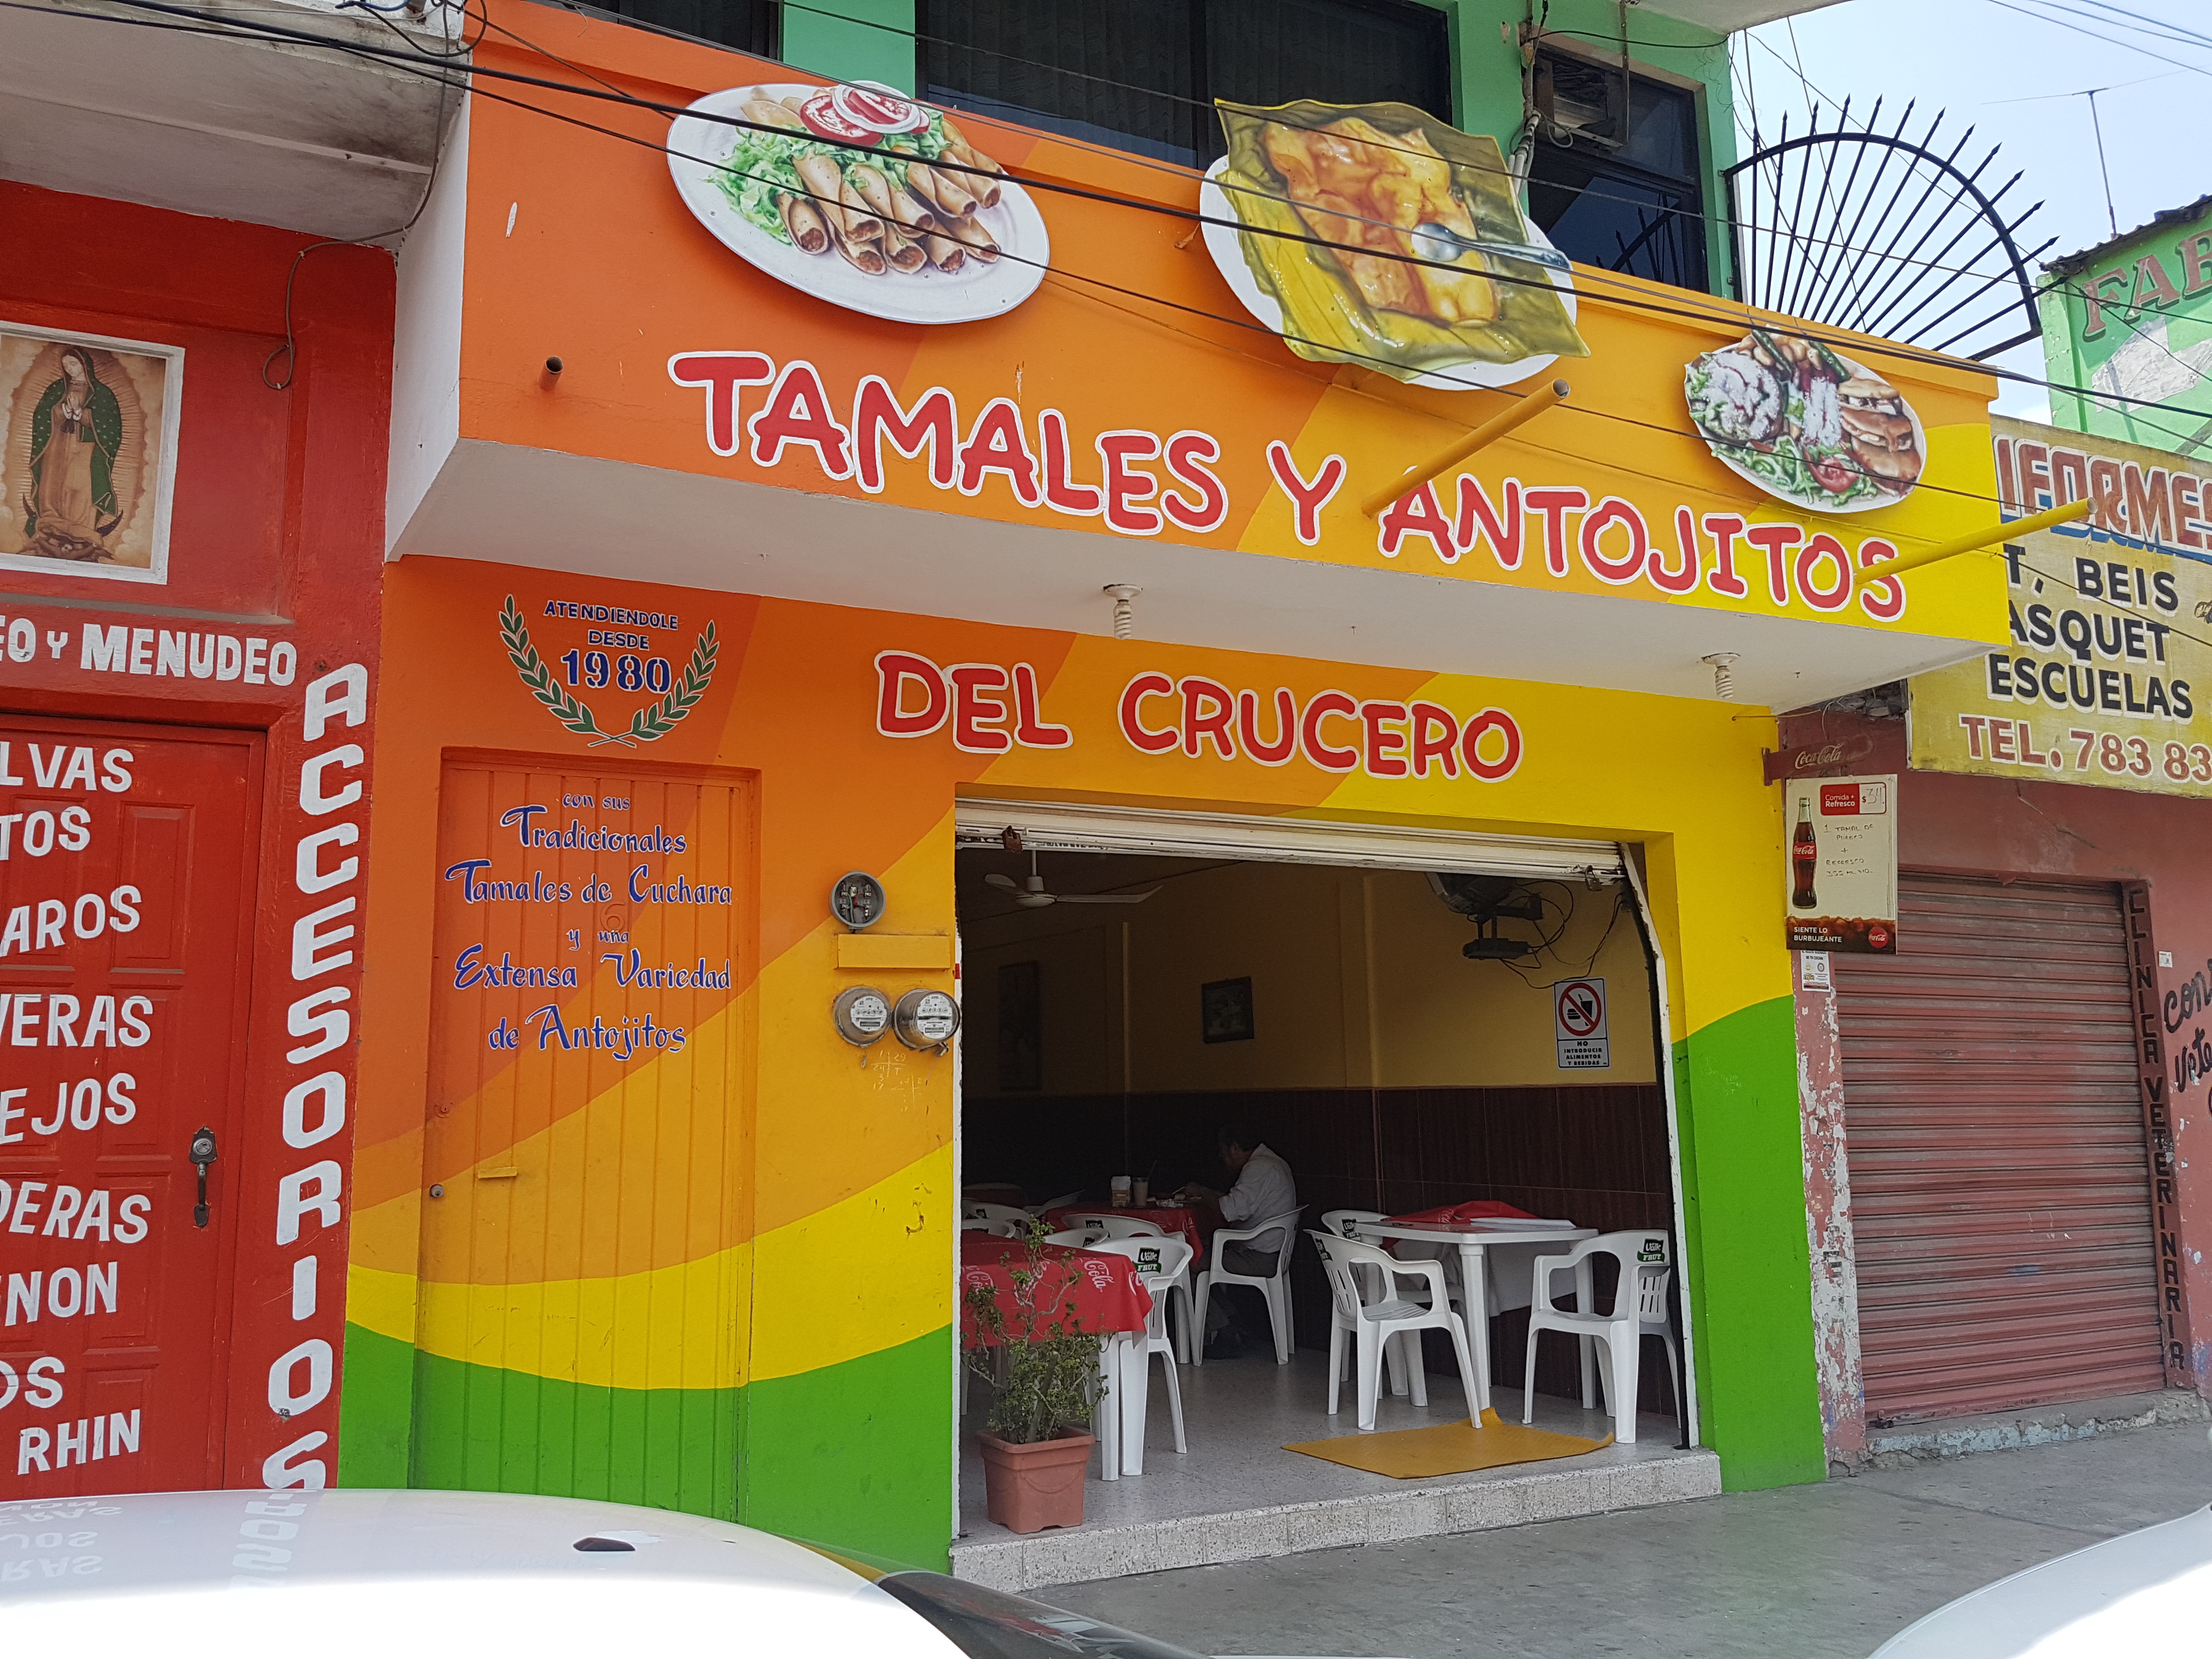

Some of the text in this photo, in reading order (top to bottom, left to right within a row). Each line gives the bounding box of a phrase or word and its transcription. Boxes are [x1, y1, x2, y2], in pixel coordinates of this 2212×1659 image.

[668, 351, 1906, 623] TAMALES Y ANTOJITOS
[543, 600, 679, 630] ATENDIENDOLE
[2074, 556, 2179, 616] BEIS
[47, 630, 68, 658] Y
[80, 623, 297, 686] MENUDEO
[588, 629, 650, 651] DESDE
[560, 648, 672, 694] 1980
[1987, 653, 2194, 725] ESCUELAS
[874, 650, 1523, 783] DEL CRUCERO
[2069, 727, 2153, 776] 783
[500, 805, 687, 855] Tradicionales
[562, 793, 630, 810] con sus
[445, 859, 732, 905] Tamales de Cuchara
[0, 884, 142, 956] AROS
[566, 929, 629, 950] y una
[454, 943, 731, 990] Extensa Variedad
[2129, 888, 2159, 1064] CLINICA
[488, 1004, 687, 1061] de Antojitos
[262, 663, 368, 1489] ACCESORIOS
[0, 1073, 136, 1144] EJOS
[2144, 1077, 2185, 1370] VETERINARIA
[1140, 1252, 1158, 1261] Valle
[18, 1408, 141, 1475] RHIN
